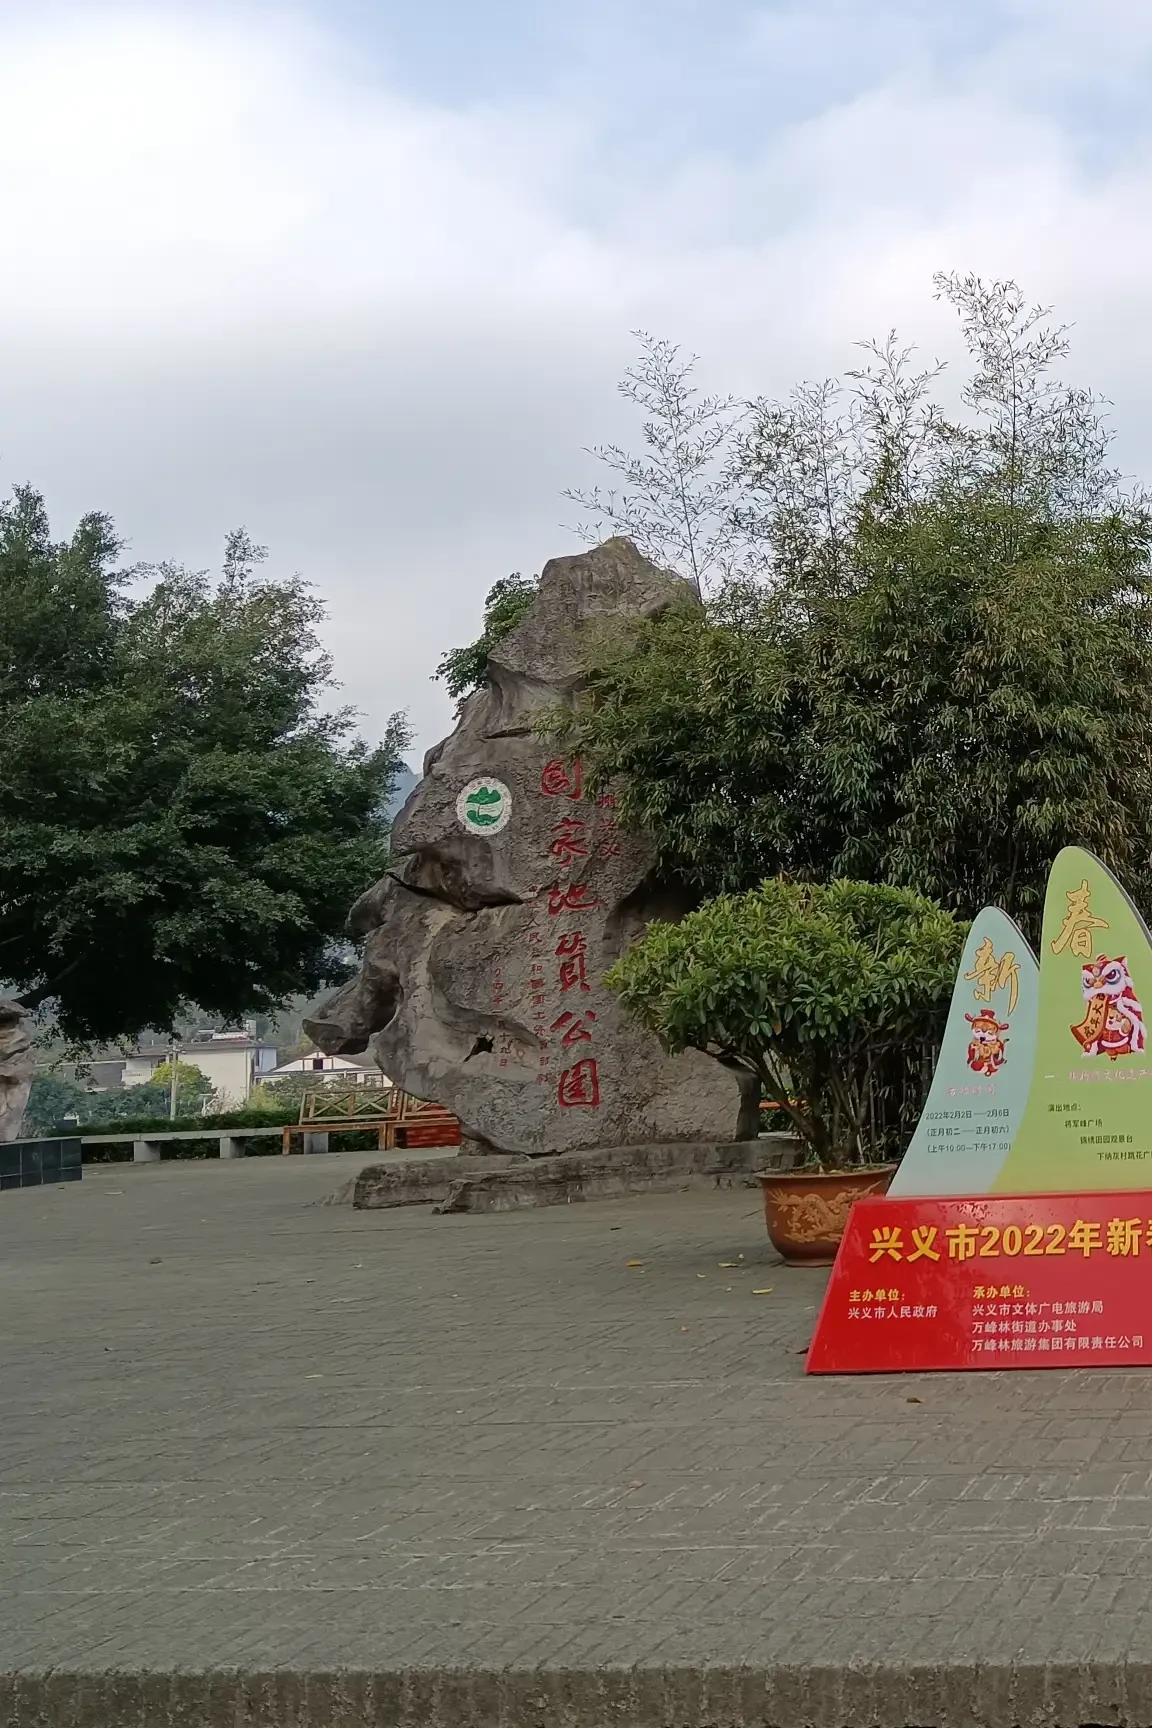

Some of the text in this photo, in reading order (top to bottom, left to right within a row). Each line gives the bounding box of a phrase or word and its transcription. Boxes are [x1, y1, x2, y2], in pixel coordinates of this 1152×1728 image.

[964, 936, 1021, 1017] 新
[1051, 879, 1110, 958] 春
[847, 1304, 938, 1320] 兴义市人民政府
[972, 1300, 1104, 1317] 兴义市文体广电旅游局
[972, 1319, 1077, 1334] 万峰林街道办事处
[971, 1335, 1144, 1352] 万峰林旅游集团有限责任公司
